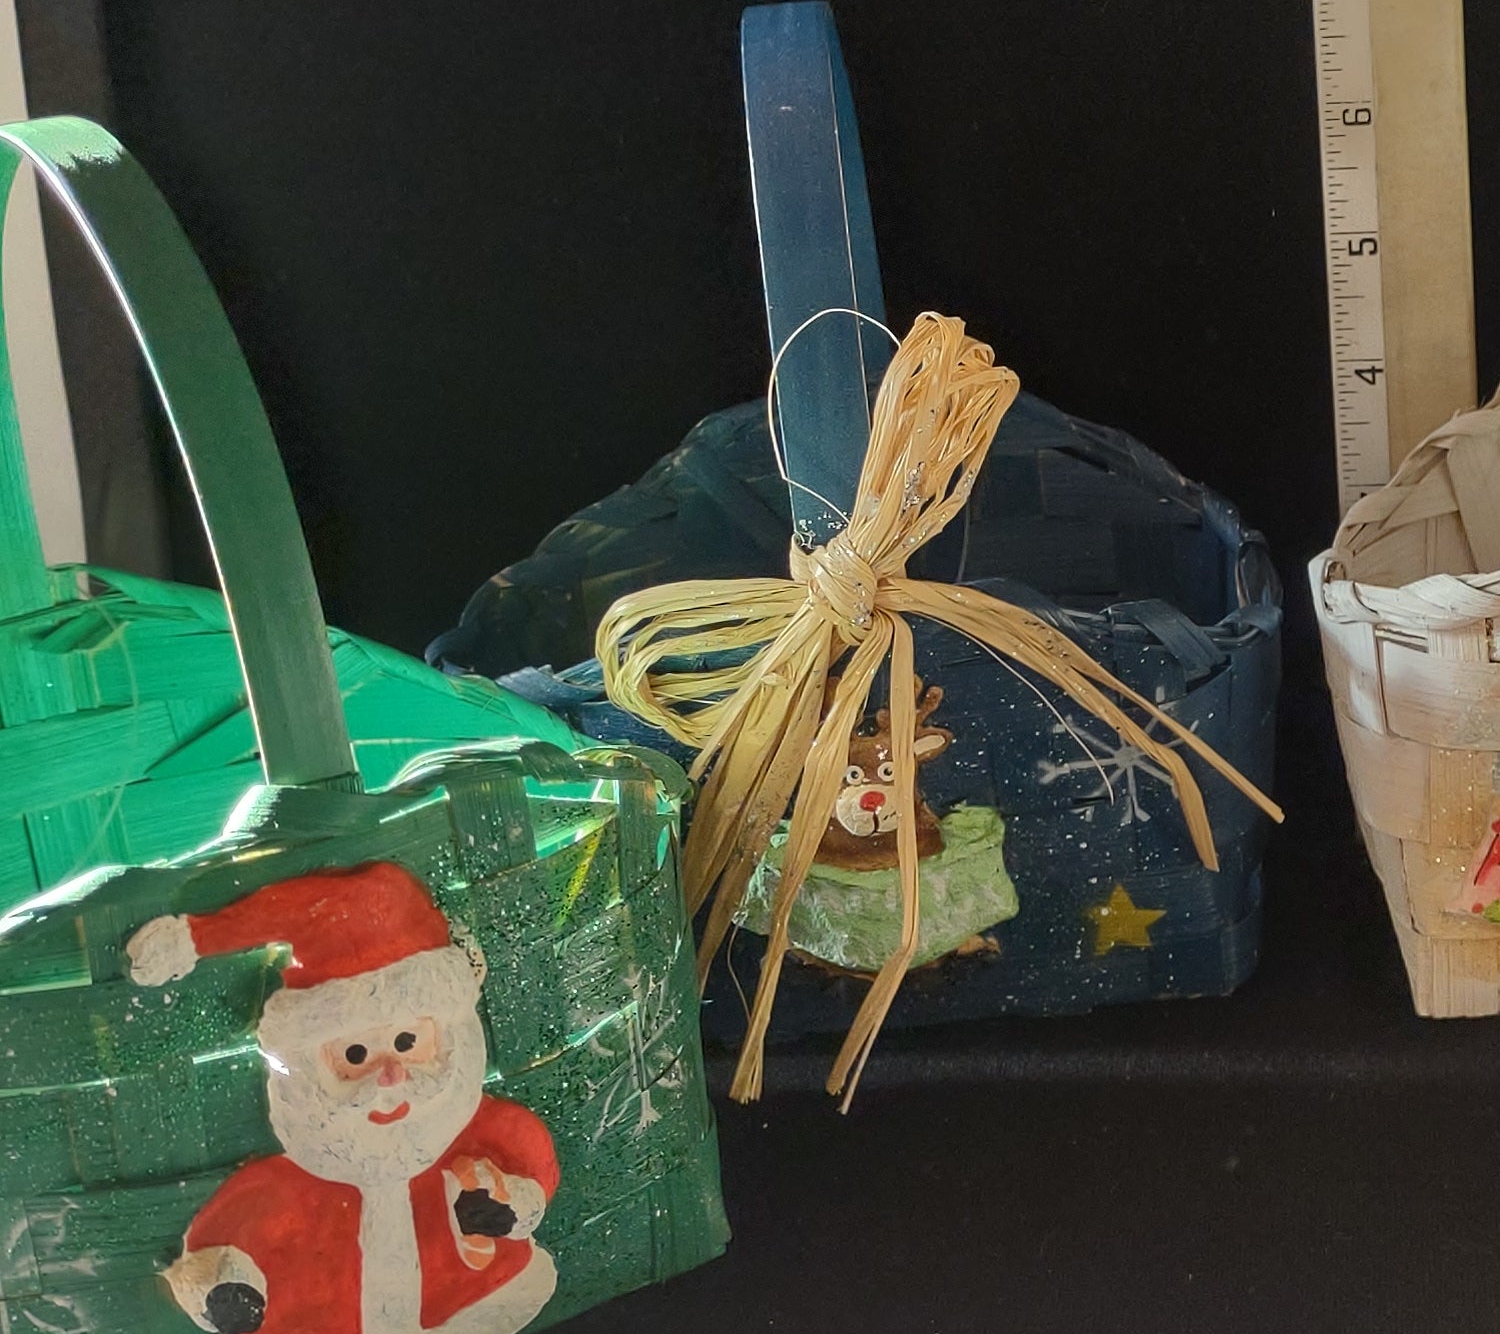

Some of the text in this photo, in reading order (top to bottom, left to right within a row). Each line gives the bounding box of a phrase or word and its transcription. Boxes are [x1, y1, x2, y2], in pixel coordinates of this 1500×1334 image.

[1342, 107, 1372, 127] 6
[1347, 236, 1378, 257] 5
[1354, 365, 1385, 386] 4
